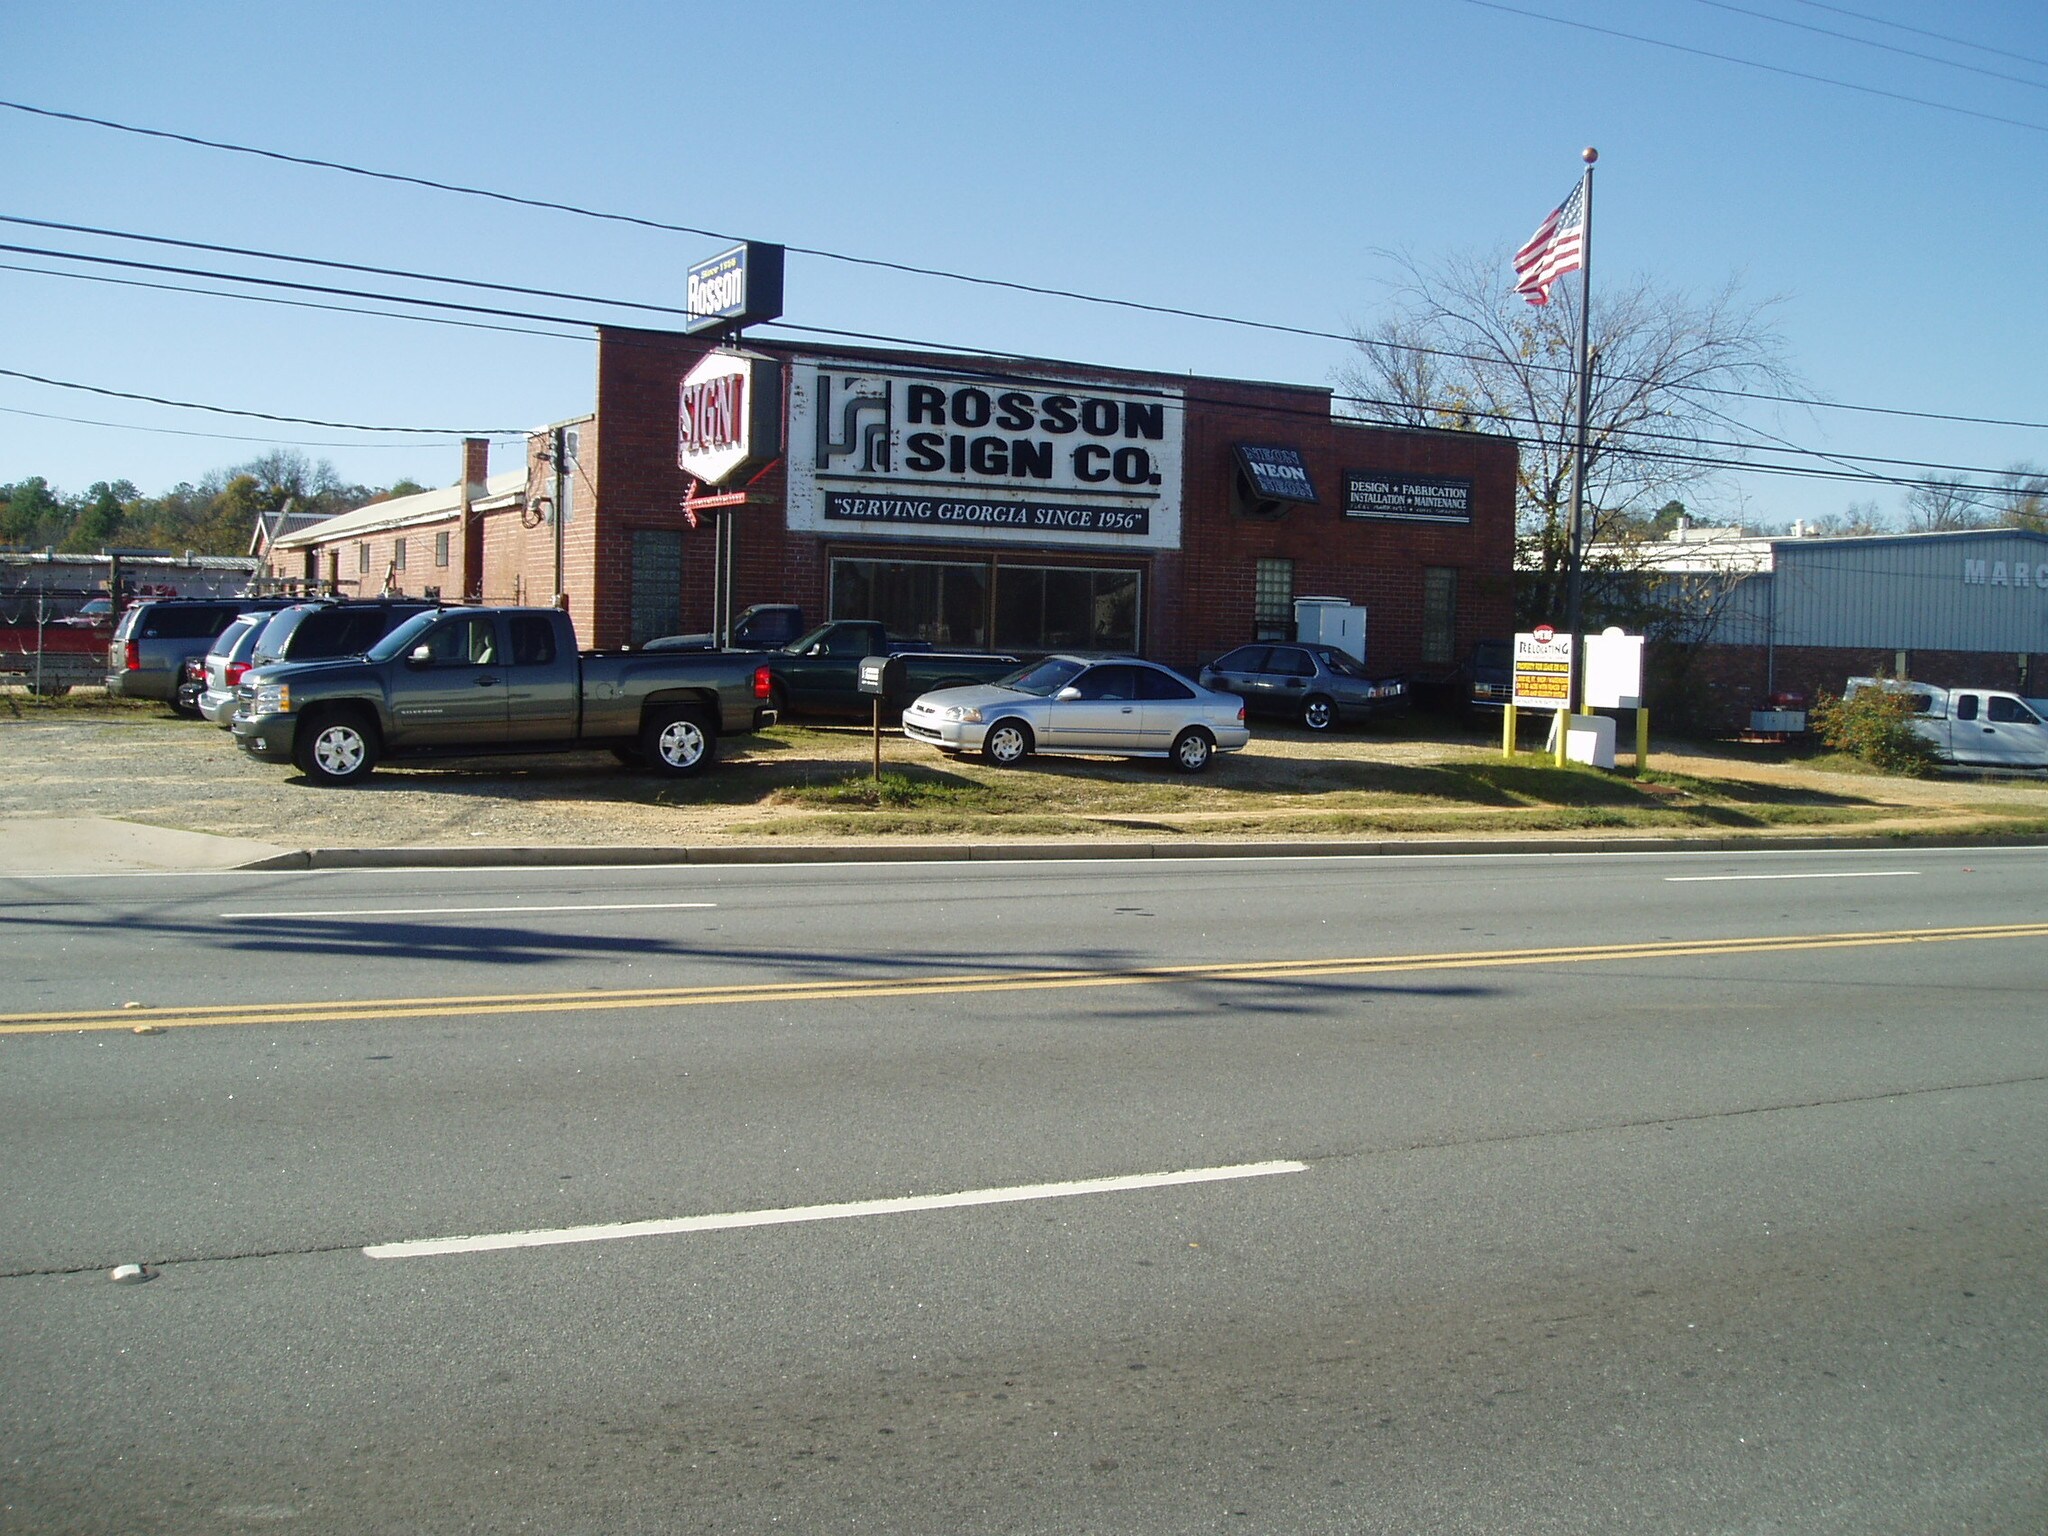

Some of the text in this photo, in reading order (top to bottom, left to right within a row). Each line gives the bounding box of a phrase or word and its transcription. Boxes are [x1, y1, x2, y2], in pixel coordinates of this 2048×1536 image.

[688, 268, 742, 321] Rosson
[907, 385, 1164, 440] ROSSON
[905, 432, 1162, 485] SIGN CO.
[1249, 461, 1306, 481] NEON
[1350, 481, 1467, 498] DESIGN FABRICATION
[1350, 492, 1406, 505] INSTALLATION
[1414, 496, 1467, 509] MAINTENANCE
[938, 503, 1027, 523] GEORGIA
[1035, 508, 1092, 526] SINCE
